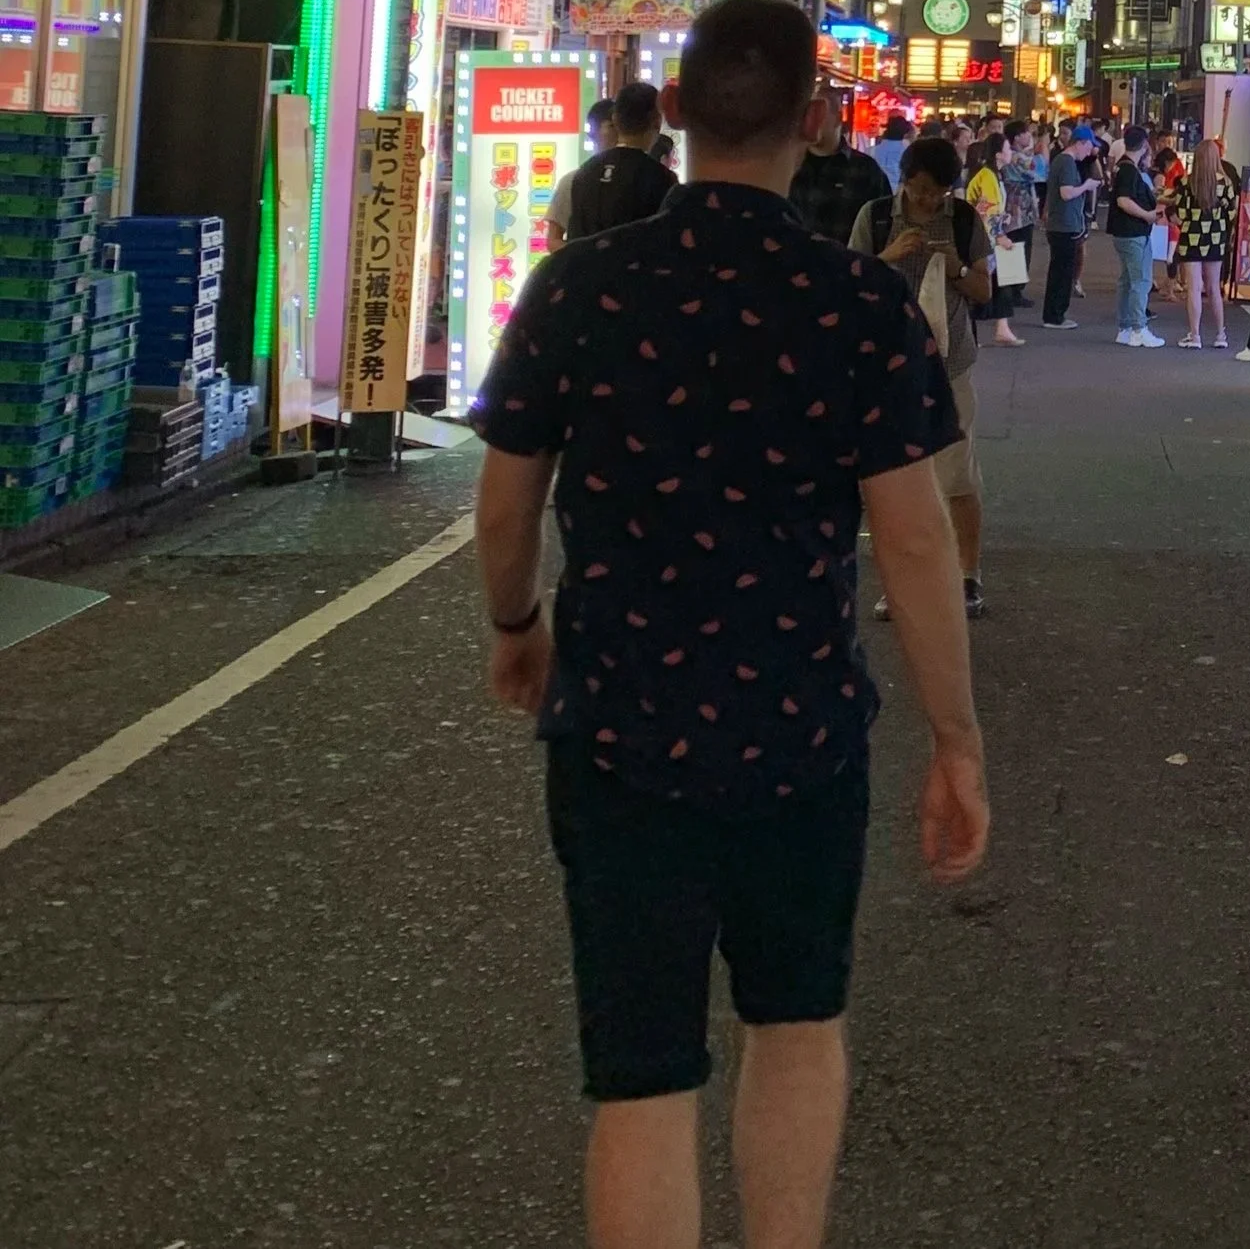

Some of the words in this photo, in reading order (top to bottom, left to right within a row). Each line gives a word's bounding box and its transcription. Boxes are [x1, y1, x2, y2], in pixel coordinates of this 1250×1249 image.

[500, 88, 556, 104] TICKET
[490, 105, 564, 122] COUNTER
[392, 117, 419, 318] 客引きにはついていかない
